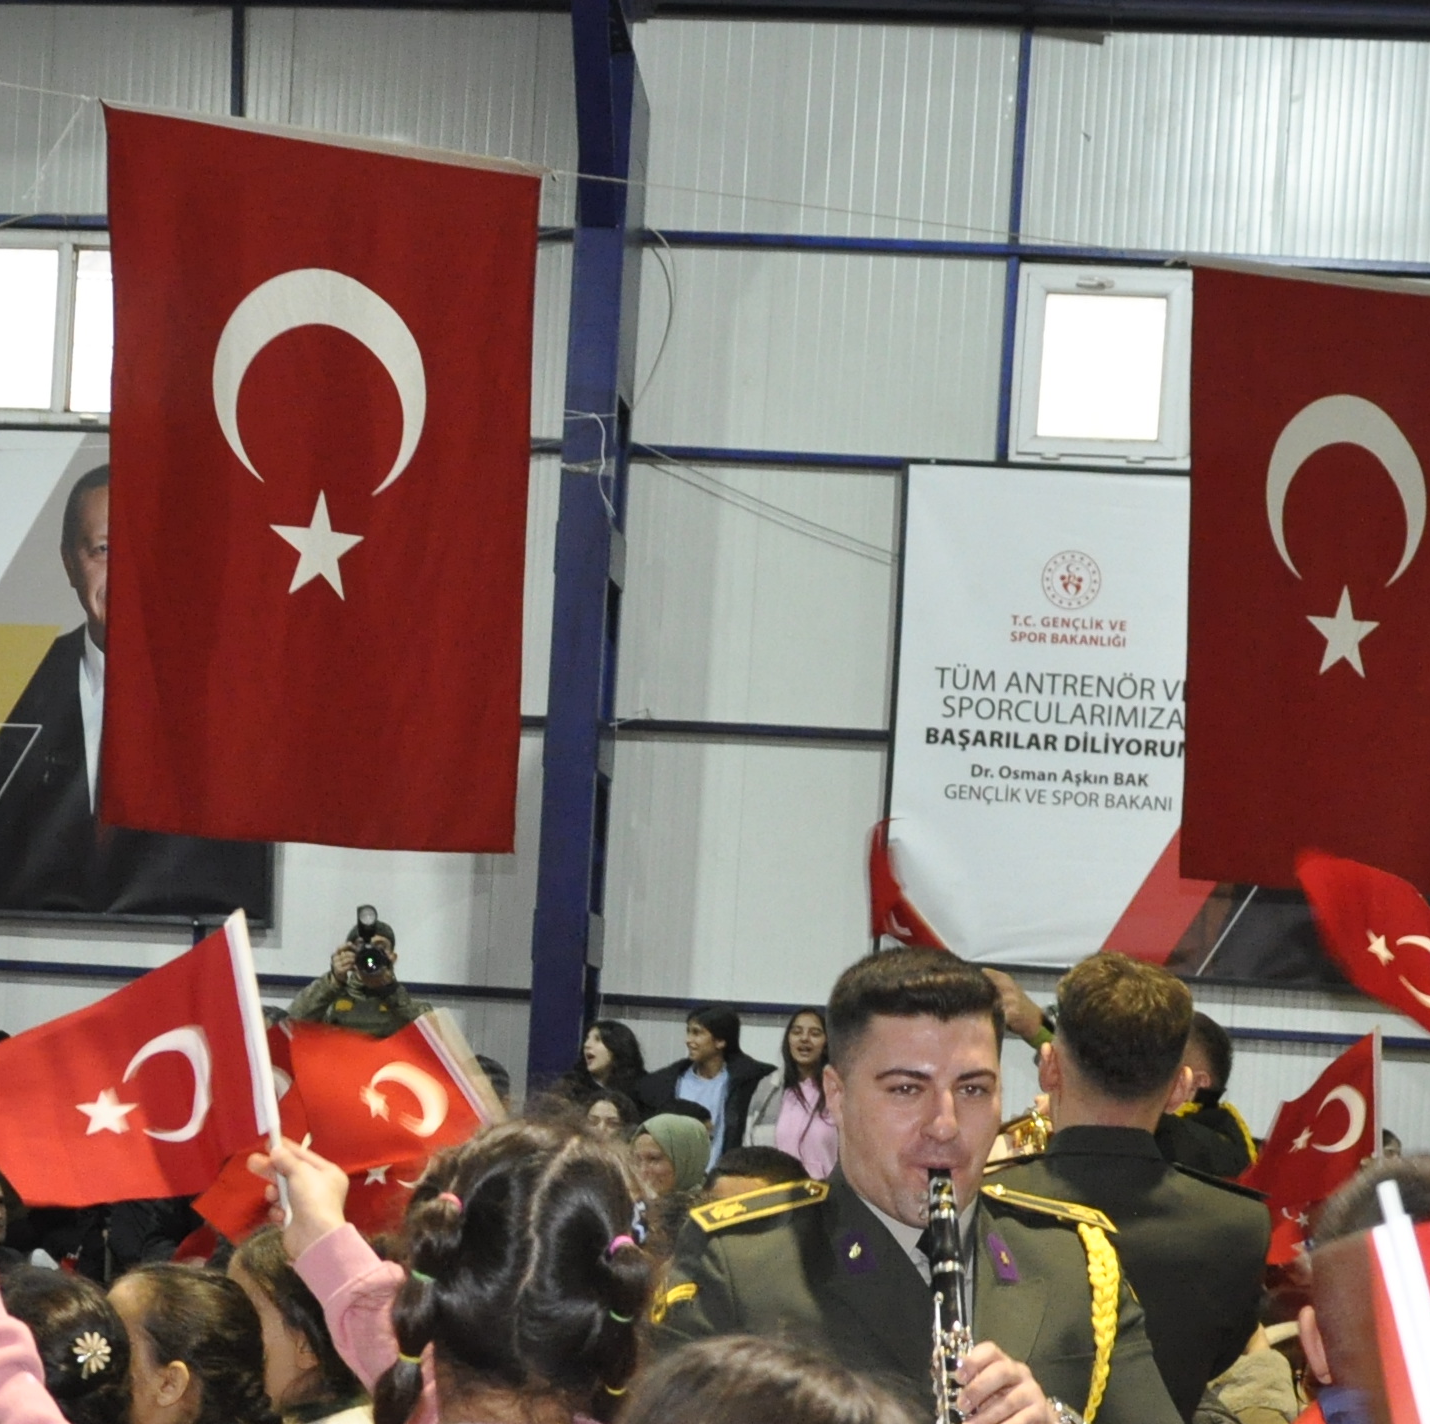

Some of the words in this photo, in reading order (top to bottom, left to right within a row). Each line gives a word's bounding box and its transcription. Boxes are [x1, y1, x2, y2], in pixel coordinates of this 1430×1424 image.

[1011, 615, 1036, 628] T.C.
[1041, 616, 1104, 631] GENÇLİK
[1109, 620, 1127, 632] VE
[1011, 631, 1046, 643] SPOR
[1051, 632, 1126, 648] BAKANLIĞI
[935, 663, 996, 693] TÜM
[1005, 671, 1155, 701] ANTRENÖR
[1163, 679, 1185, 702] V
[941, 695, 1184, 730] SPORCULARIMIZA
[925, 727, 1057, 751] BAŞARILAR
[970, 763, 994, 779] Dr.
[999, 766, 1057, 782] Osman
[1062, 769, 1109, 787] Aşkın
[1113, 772, 1149, 787] BAK
[944, 784, 1021, 805] GENÇLİK
[1025, 788, 1047, 804] VE
[1052, 790, 1100, 808] SPOR
[1104, 793, 1173, 812] BAKANI
